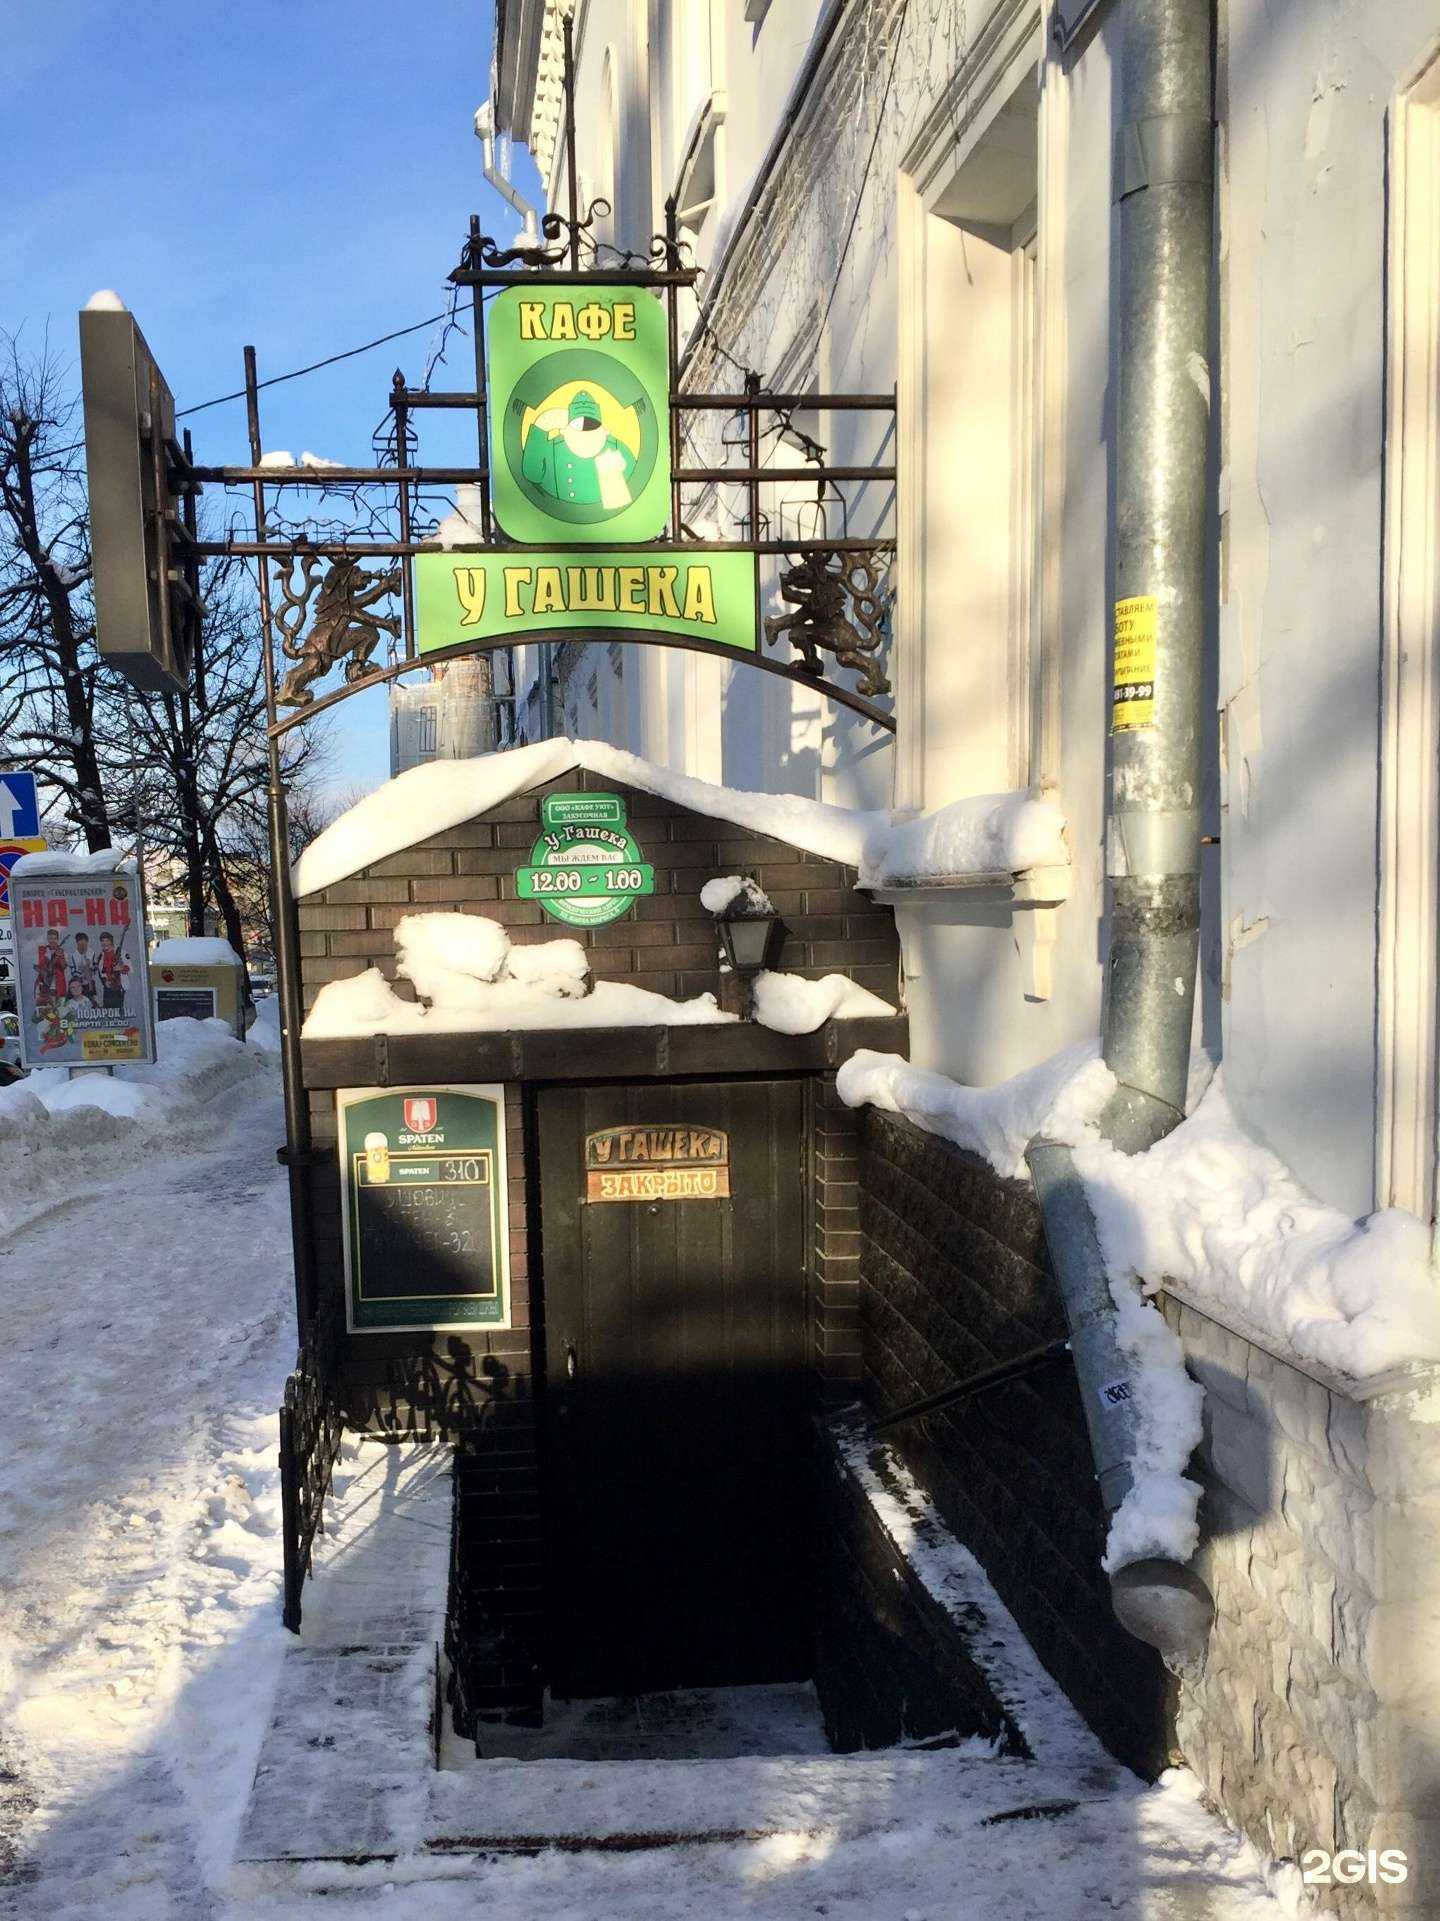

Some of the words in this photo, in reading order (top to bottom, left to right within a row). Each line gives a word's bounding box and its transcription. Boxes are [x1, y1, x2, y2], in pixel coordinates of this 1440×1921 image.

[519, 302, 636, 341] КАФЕ
[453, 567, 486, 626] У
[503, 565, 717, 625] ГАШЕКА
[531, 870, 582, 893] 12.00
[604, 868, 642, 890] 1.00
[398, 1133, 445, 1144] SPATEN
[595, 1136, 612, 1162] У
[619, 1131, 720, 1161] ГАШЕКА
[399, 1167, 430, 1175] SPATEN
[601, 1172, 716, 1197] ЗАКРЫТО
